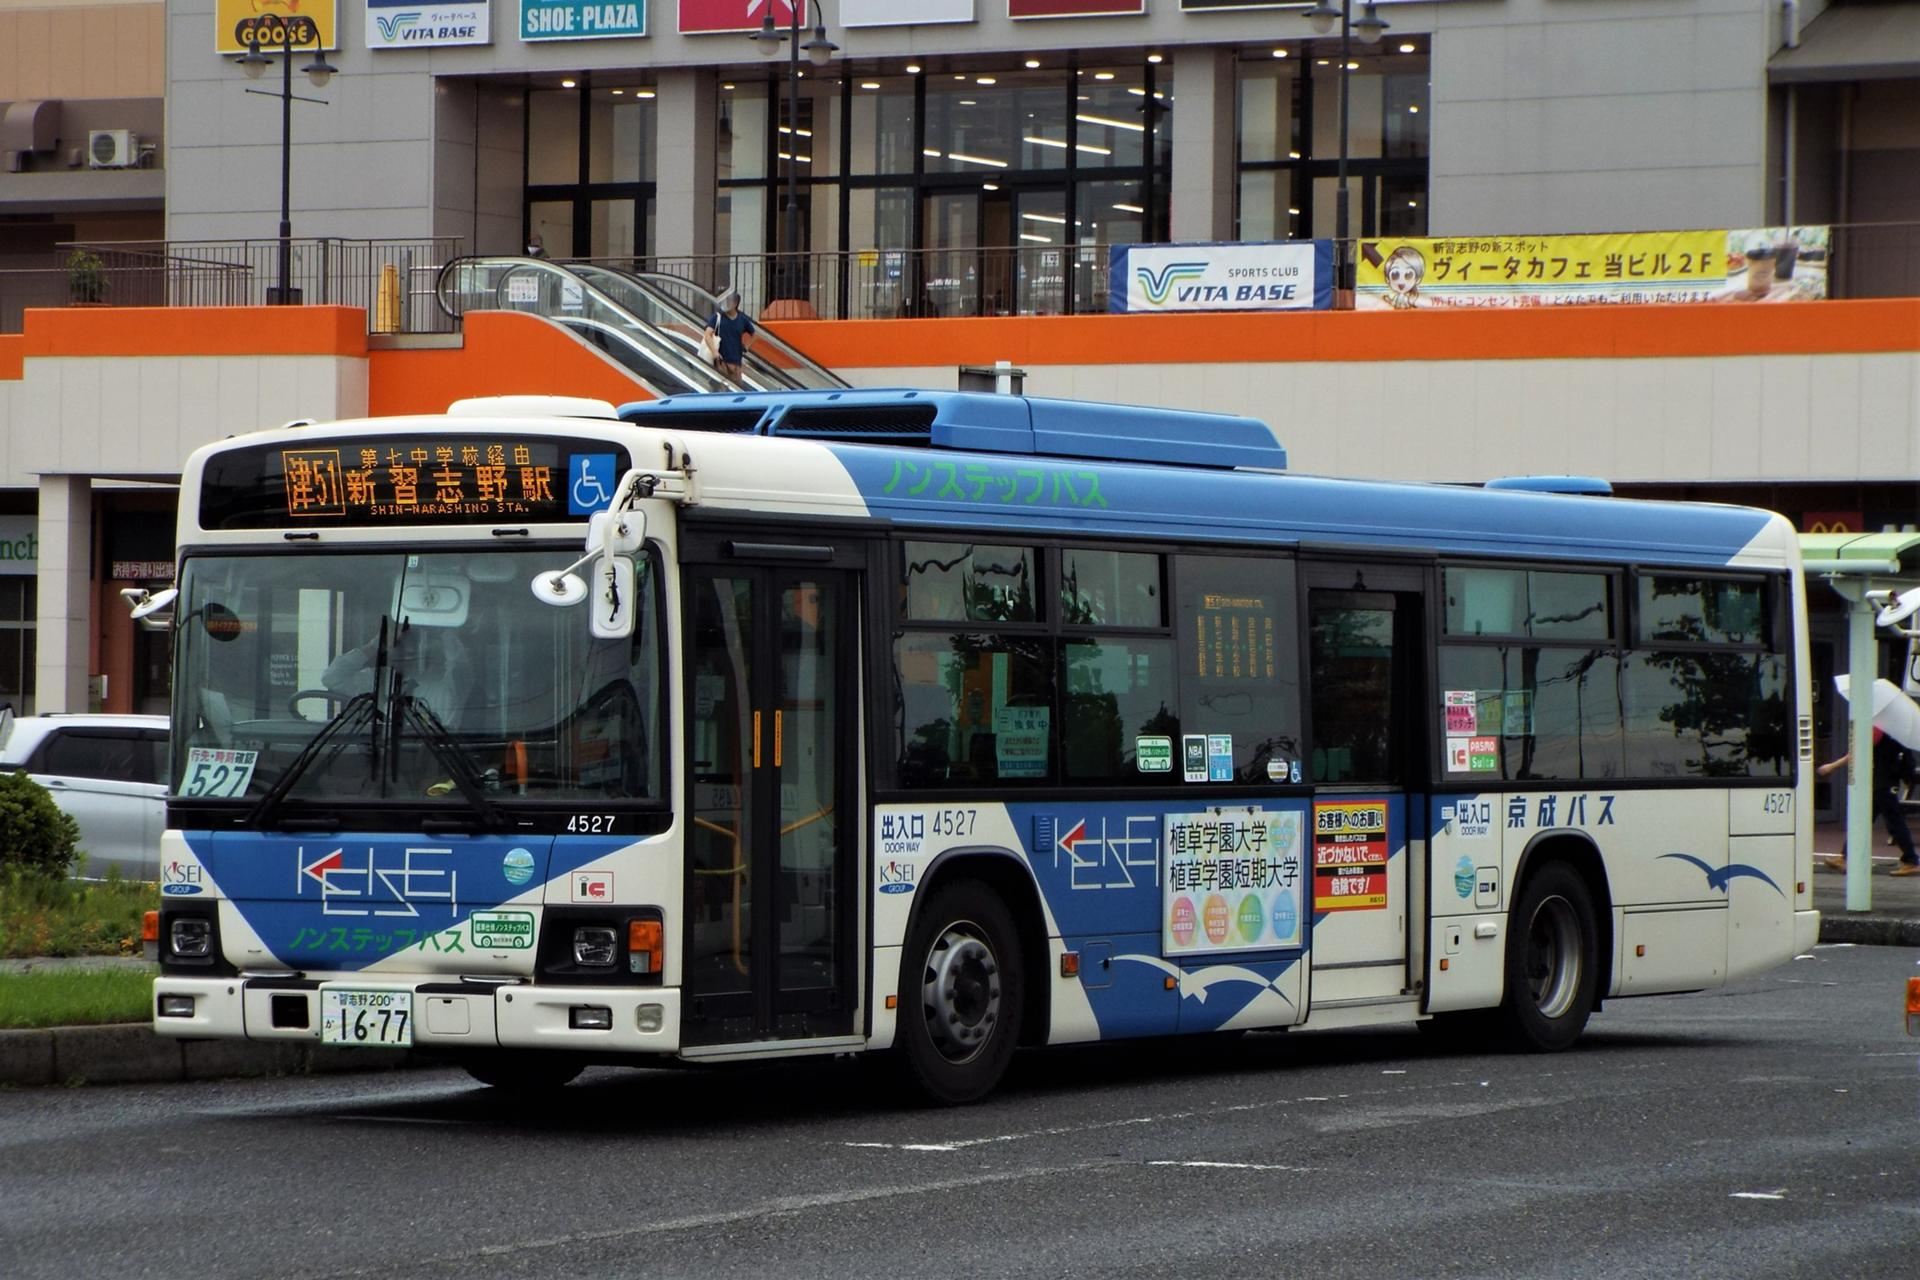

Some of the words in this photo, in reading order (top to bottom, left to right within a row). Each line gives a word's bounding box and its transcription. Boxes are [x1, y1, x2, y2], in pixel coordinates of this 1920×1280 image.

[402, 28, 434, 40] VITA
[438, 26, 476, 38] BASE
[1432, 241, 1548, 255] 新習志野の新スポット
[1228, 267, 1269, 278] SPORTS
[1271, 267, 1299, 277] CLUB
[1433, 255, 1591, 281] ヴィータカフェ
[1177, 285, 1227, 301] VITA
[1235, 284, 1297, 300] BASE
[360, 445, 530, 469] 第七中学校経由
[346, 465, 554, 506] 新習志野駅
[883, 460, 1108, 508] ノンステップバス
[371, 503, 489, 515] SHIN-NARASHINO
[497, 502, 530, 513] STA.
[1470, 741, 1495, 752] PASMO
[1471, 756, 1495, 769] Suica
[187, 764, 249, 798] 527
[1459, 803, 1490, 824] 出入口
[1507, 794, 1615, 828] 京成バス
[1764, 793, 1791, 814] 4527
[566, 815, 616, 834] 4527
[881, 815, 924, 840] 出入口
[933, 810, 977, 836] 4527
[1318, 811, 1384, 829] お客様へのお願い
[885, 843, 905, 853] DOOR
[906, 842, 920, 853] WAY
[1170, 821, 1268, 855] 植草学園大学
[1170, 857, 1299, 892] 植草学園短期大学
[289, 928, 465, 953] ノンステップバス
[341, 1008, 408, 1042] 16-77
